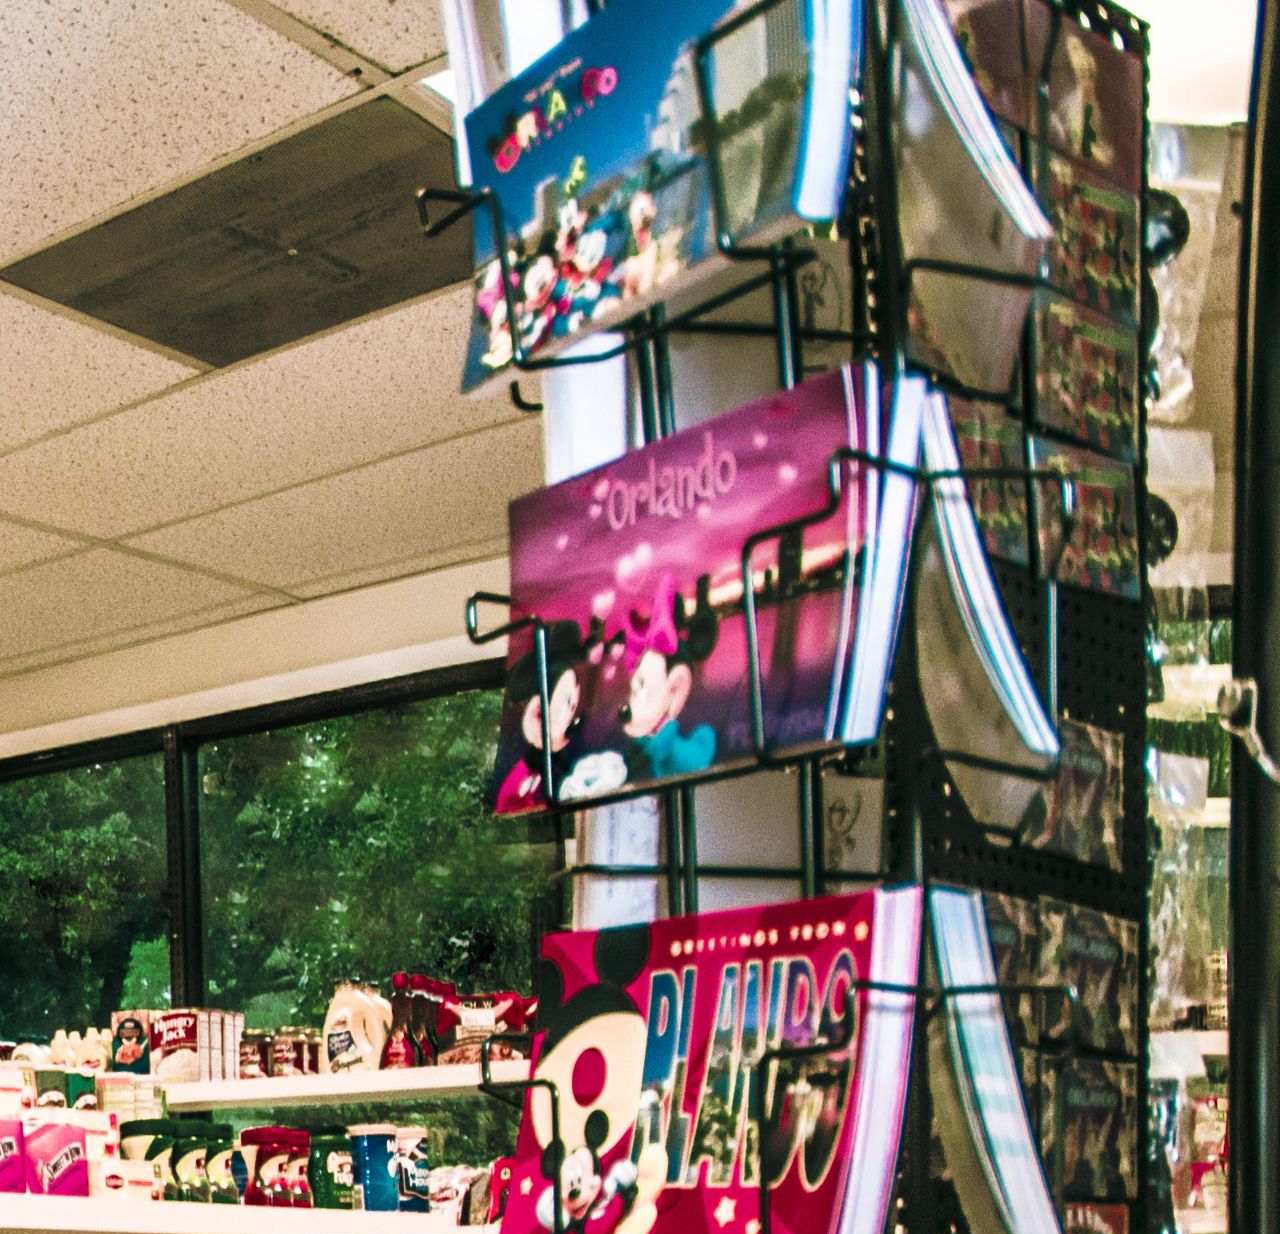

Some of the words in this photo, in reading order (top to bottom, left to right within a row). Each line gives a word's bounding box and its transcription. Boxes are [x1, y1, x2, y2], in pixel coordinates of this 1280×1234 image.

[607, 431, 738, 529] Orlando
[153, 1016, 195, 1036] Hungry
[161, 1028, 186, 1044] Jack
